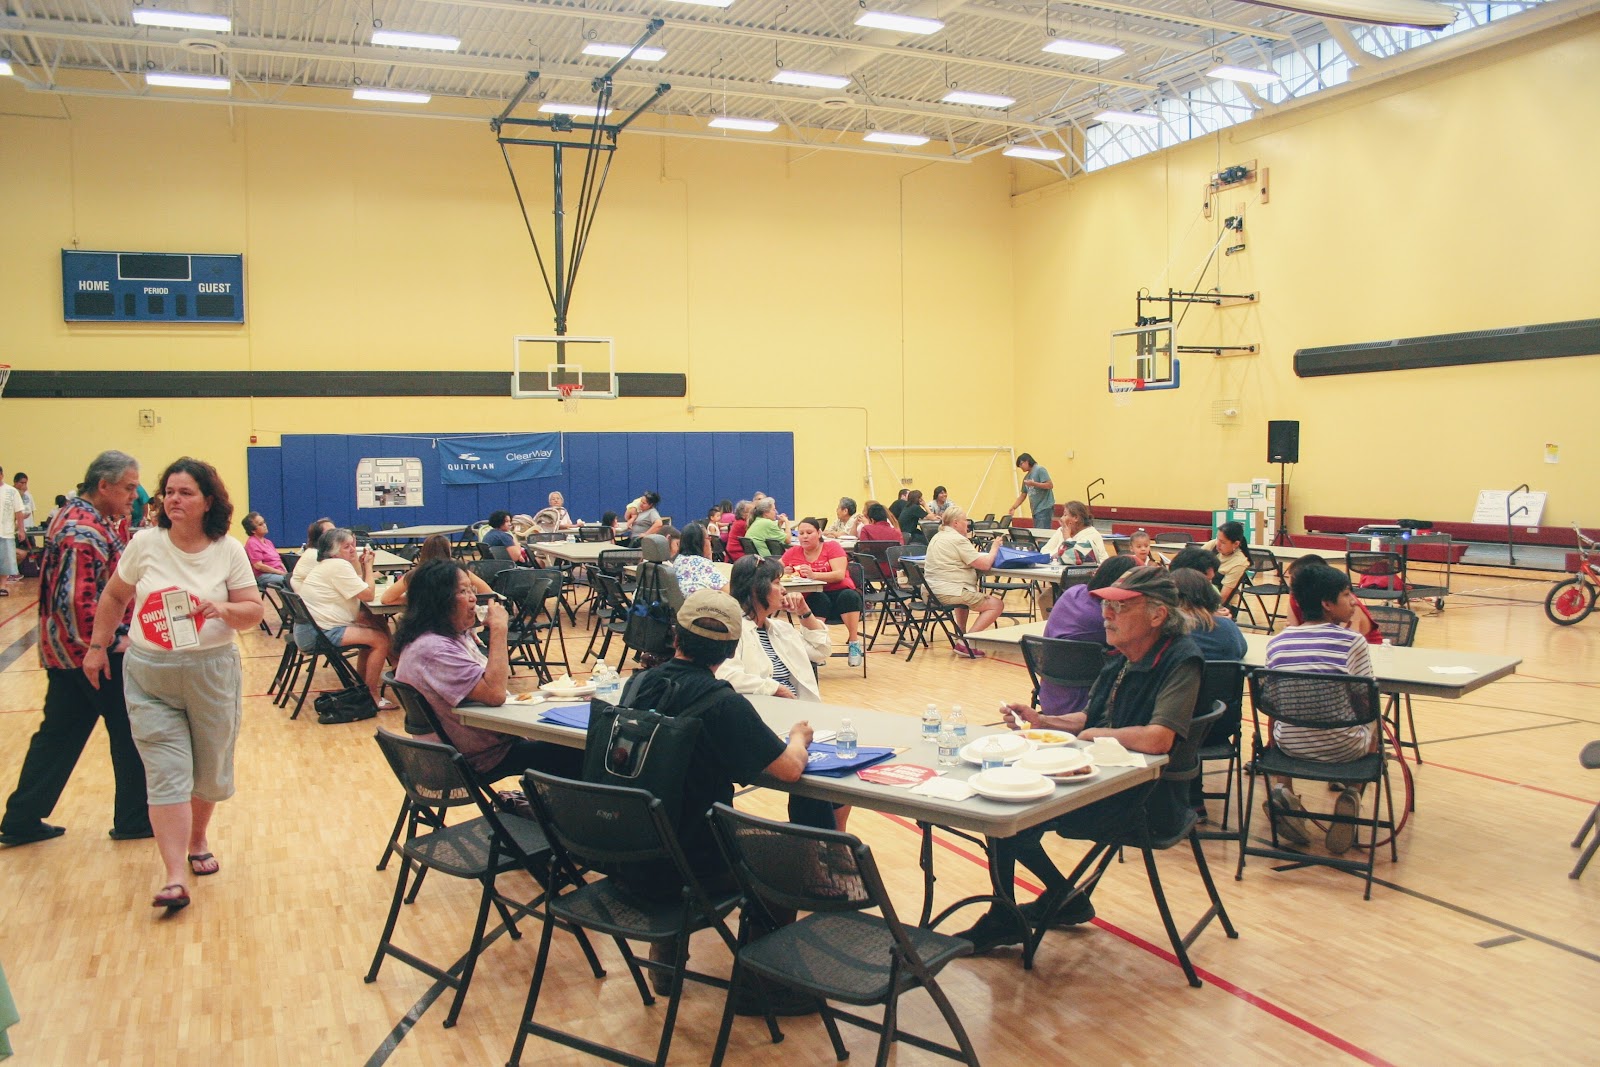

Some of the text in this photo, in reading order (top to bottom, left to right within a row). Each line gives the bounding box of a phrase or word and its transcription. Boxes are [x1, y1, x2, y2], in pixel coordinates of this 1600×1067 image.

[78, 280, 110, 291] HOME
[143, 287, 169, 295] PERIOD
[198, 282, 231, 294] GUEST
[505, 449, 554, 461] ClearWay
[447, 463, 495, 471] QUITPLAN
[142, 608, 166, 624] KING
